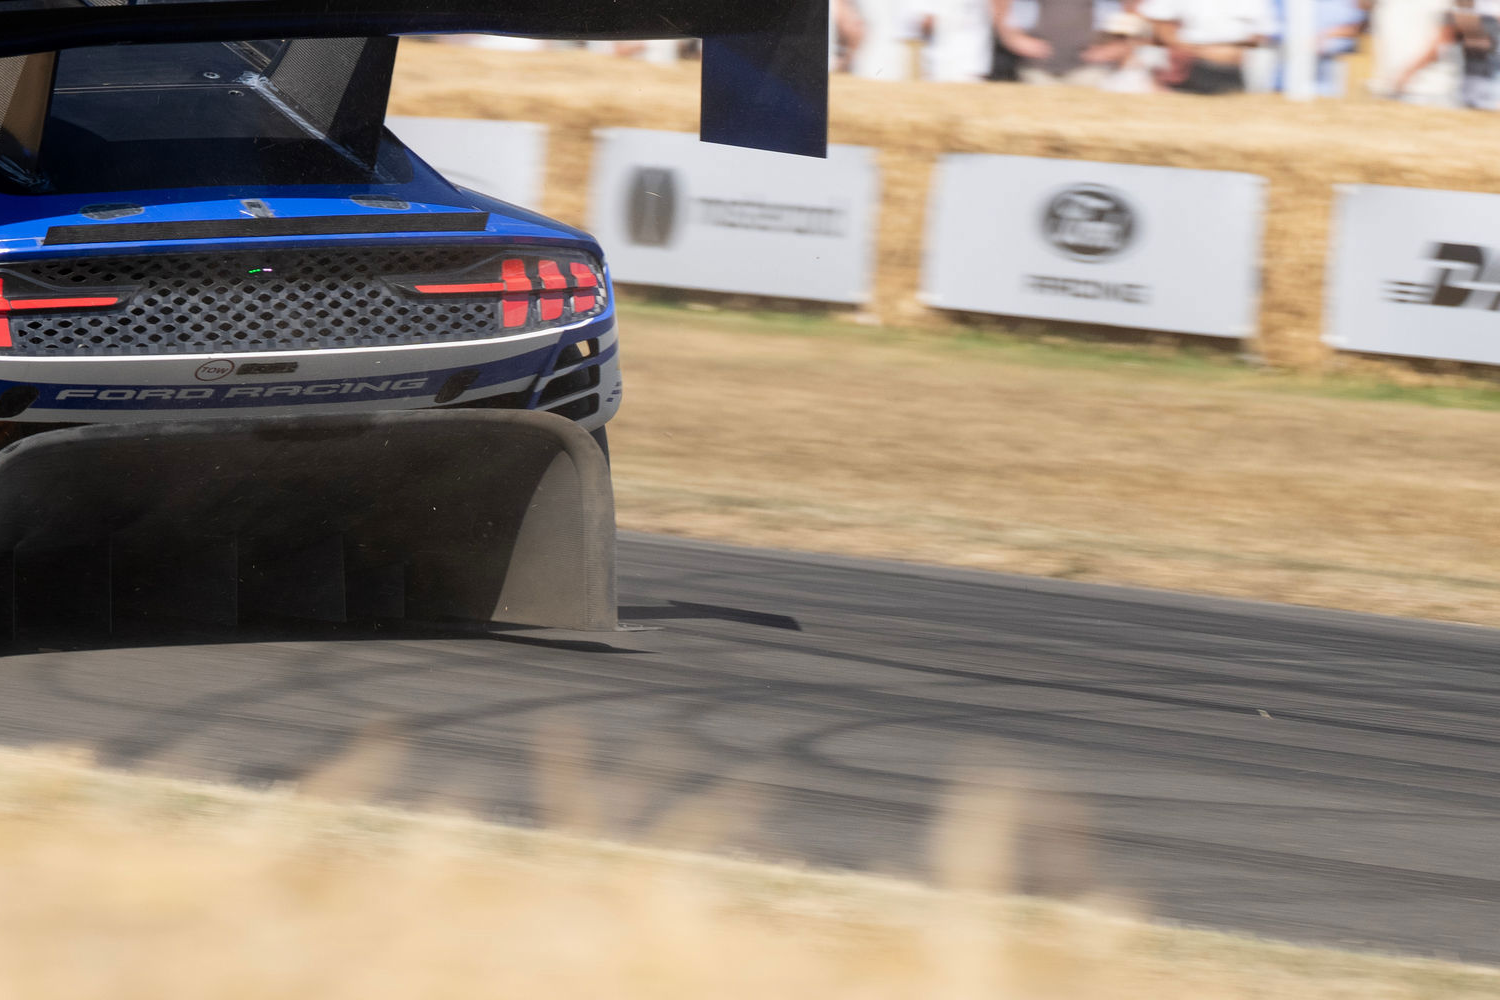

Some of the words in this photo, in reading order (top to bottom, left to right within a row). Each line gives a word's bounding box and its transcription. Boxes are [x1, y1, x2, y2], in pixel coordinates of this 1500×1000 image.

[201, 365, 229, 375] TOW
[55, 388, 214, 401] FORD
[224, 377, 429, 399] RACING
